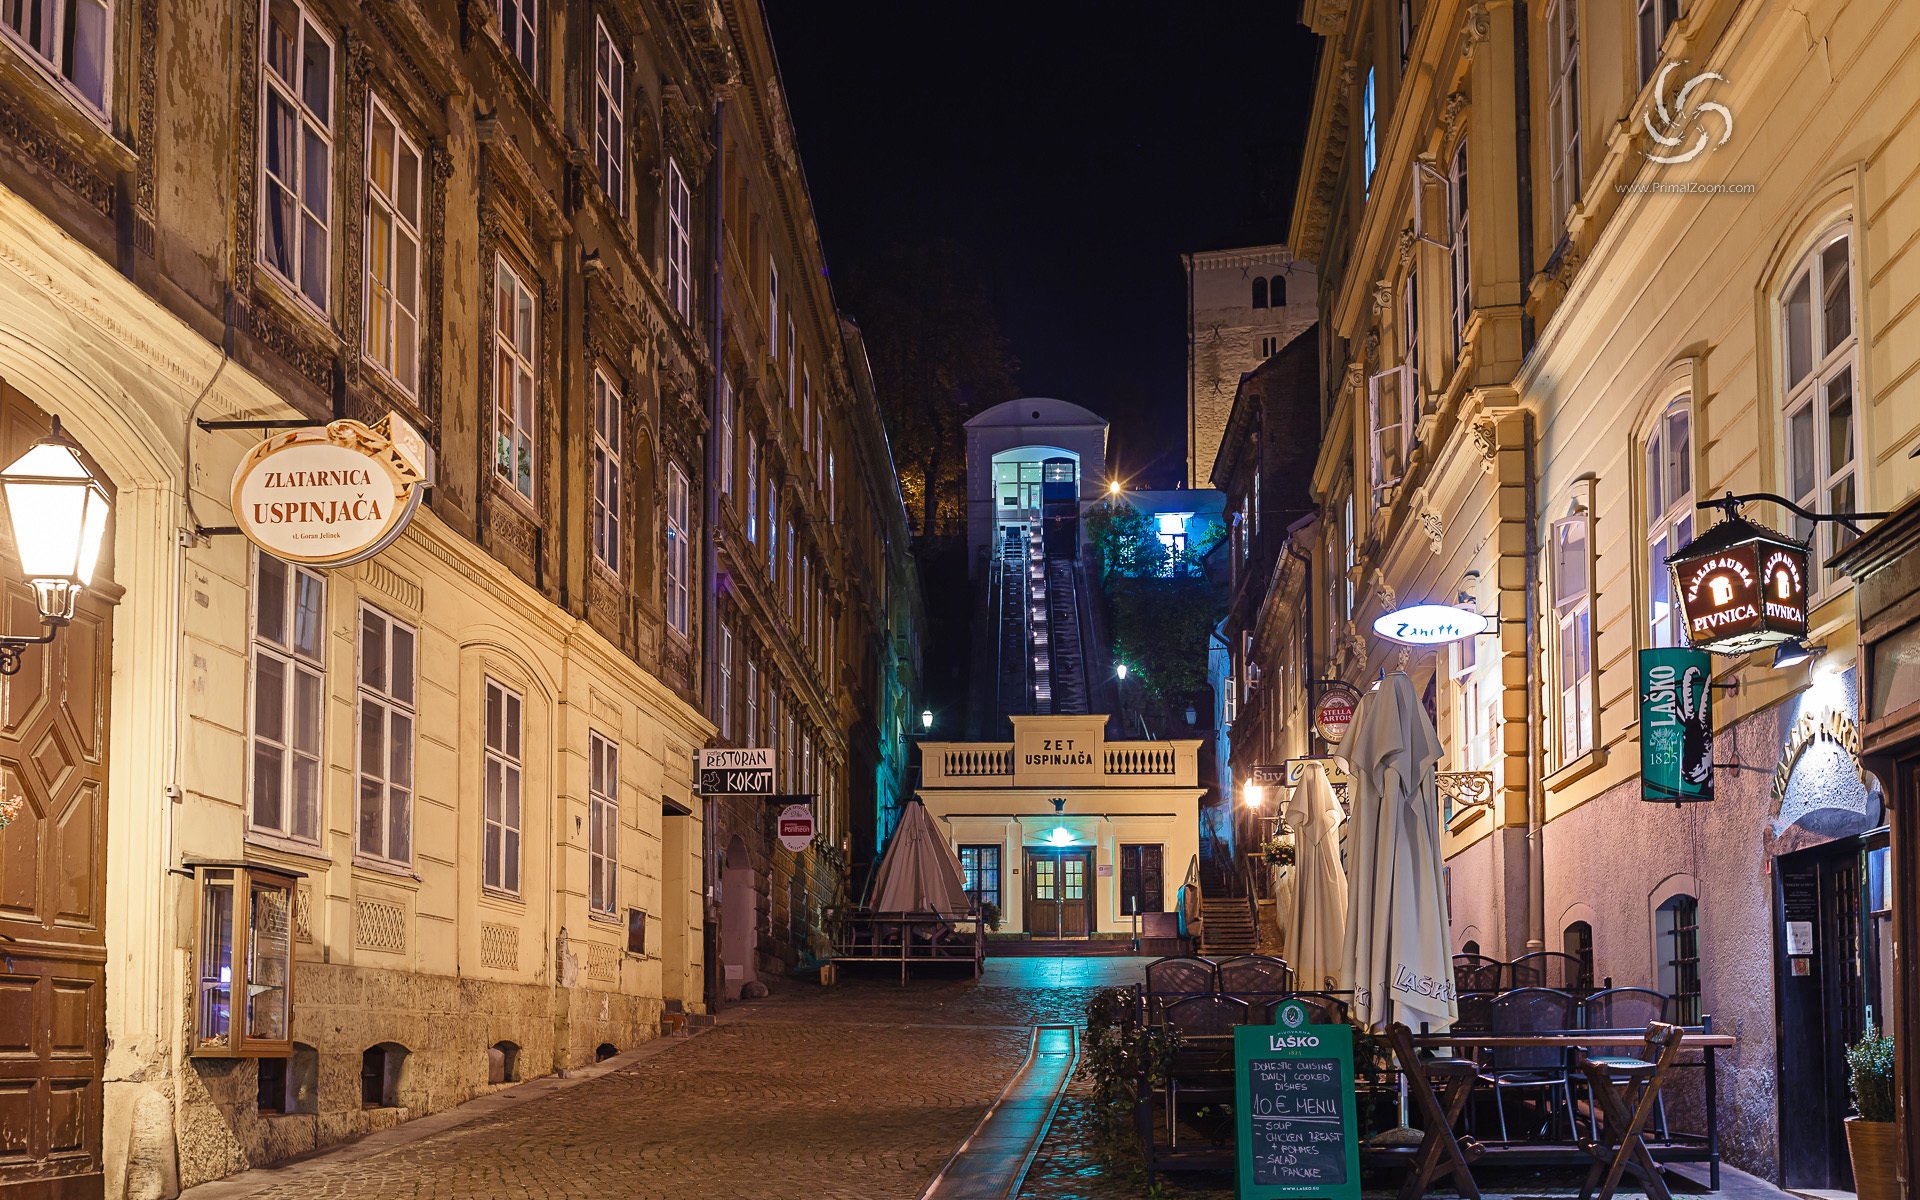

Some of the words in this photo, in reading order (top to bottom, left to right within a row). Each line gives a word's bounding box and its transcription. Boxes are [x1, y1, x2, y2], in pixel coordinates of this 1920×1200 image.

[264, 469, 371, 488] ZLATARNICA
[253, 493, 382, 524] USPINJAČA
[300, 532, 318, 540] Goran
[1688, 560, 1716, 602] VALLIS
[1718, 558, 1753, 588] AUREA
[1693, 604, 1758, 631] PIVNICA
[1765, 602, 1802, 622] PIVNICA
[1643, 665, 1676, 727] LAŠKO
[1323, 708, 1352, 716] STELLA
[1043, 739, 1074, 750] ZET
[706, 750, 767, 767] RESTORAN
[1025, 751, 1092, 765] USPINJAČA
[1650, 752, 1678, 765] 1825
[727, 771, 771, 792] KOKOT
[1270, 1035, 1320, 1051] LAŠKO
[1253, 1062, 1292, 1071] DOMESTIC
[1297, 1063, 1333, 1071] CUISINE
[1261, 1072, 1286, 1082] DAILY
[1294, 1073, 1330, 1082] COOKED
[1275, 1083, 1308, 1091] DISHES
[1296, 1097, 1337, 1114] MENU
[1265, 1122, 1291, 1130] SOUP
[1265, 1133, 1303, 1142] CHICKEN
[1309, 1131, 1343, 1142] BREAST
[1267, 1154, 1297, 1164] SALAD
[1281, 1167, 1321, 1178] PANCAKE
